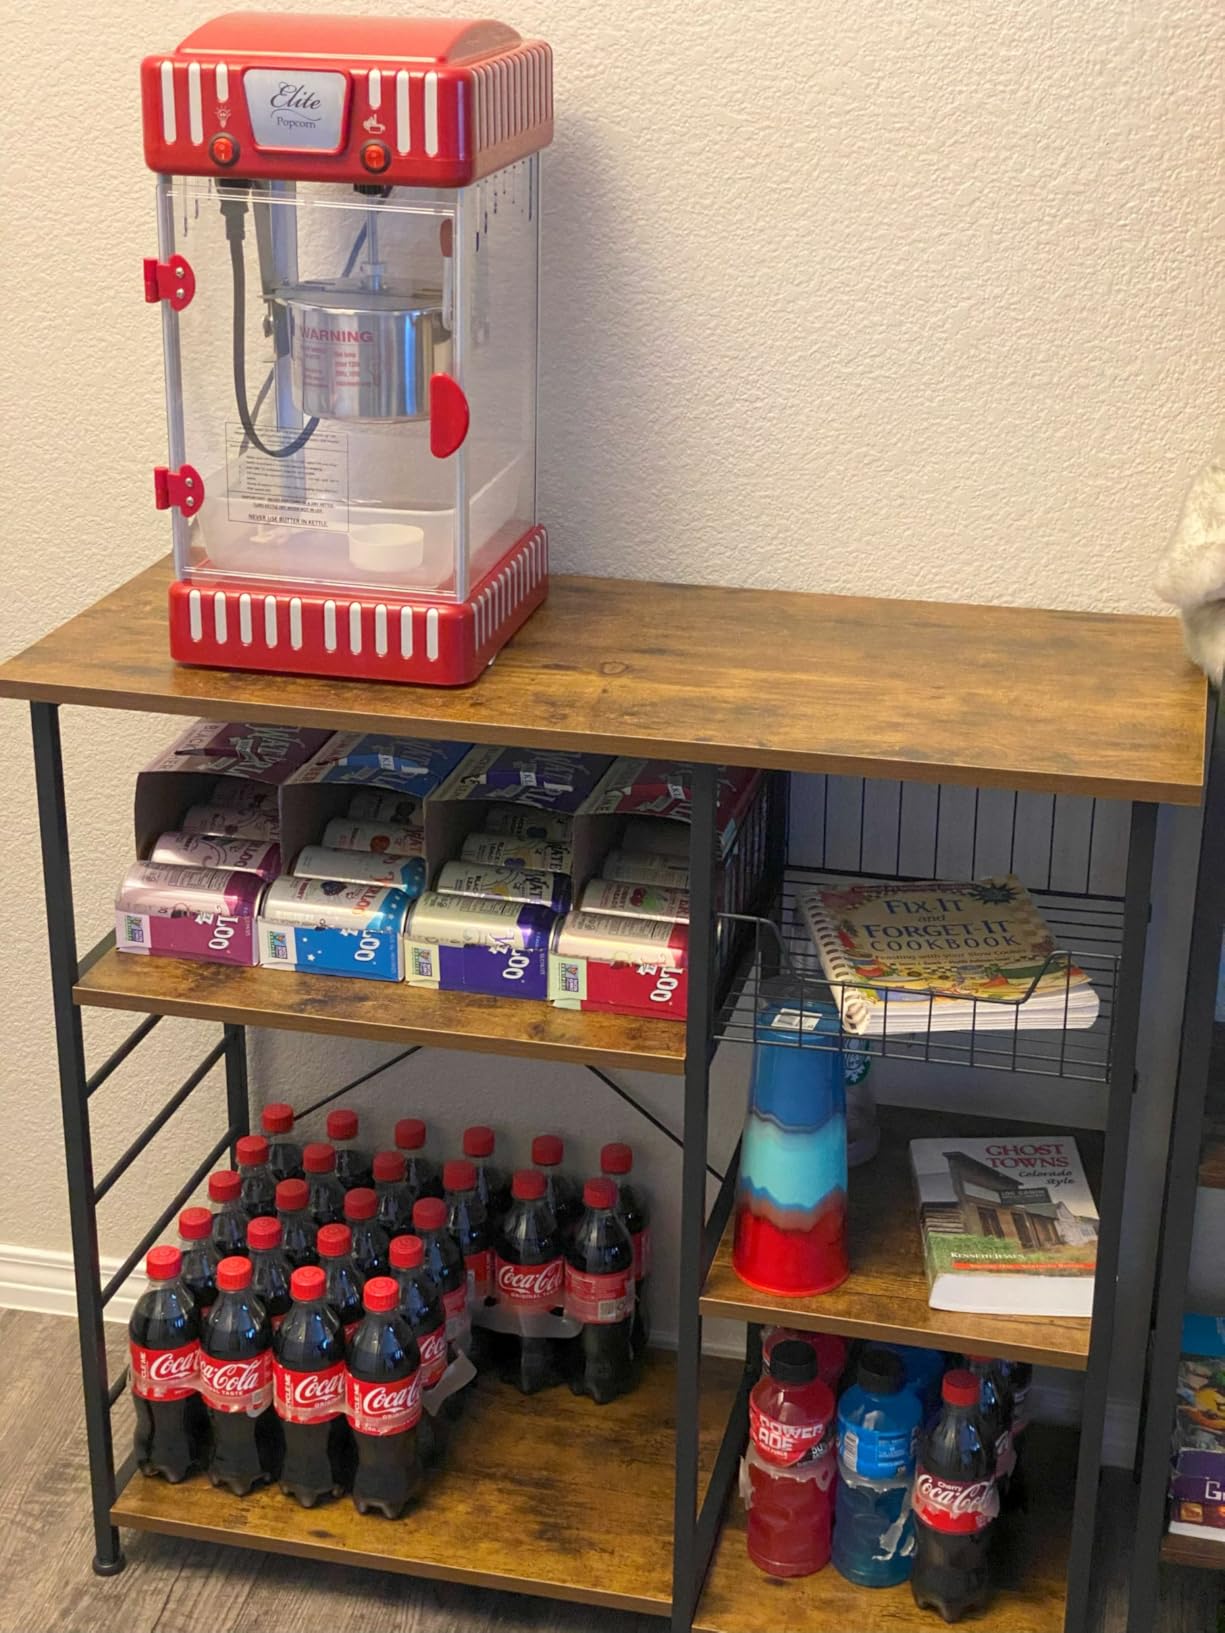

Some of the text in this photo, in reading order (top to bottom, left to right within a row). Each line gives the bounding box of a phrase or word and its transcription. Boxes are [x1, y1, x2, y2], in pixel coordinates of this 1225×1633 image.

[270, 81, 321, 110] Elite
[276, 116, 316, 129] Popcorn
[302, 327, 375, 343] WARNING
[248, 513, 266, 521] NEVER
[918, 915, 946, 923] and
[863, 920, 1014, 938] FORGET-IT
[870, 935, 1021, 951] COOKBOOK
[985, 1144, 1064, 1156] GHOST
[985, 1156, 1069, 1168] TOWNS
[1018, 1168, 1072, 1177] Colorado
[759, 1414, 823, 1438] POWER
[758, 1427, 793, 1452] ADE
[937, 1481, 963, 1492] Cherry
